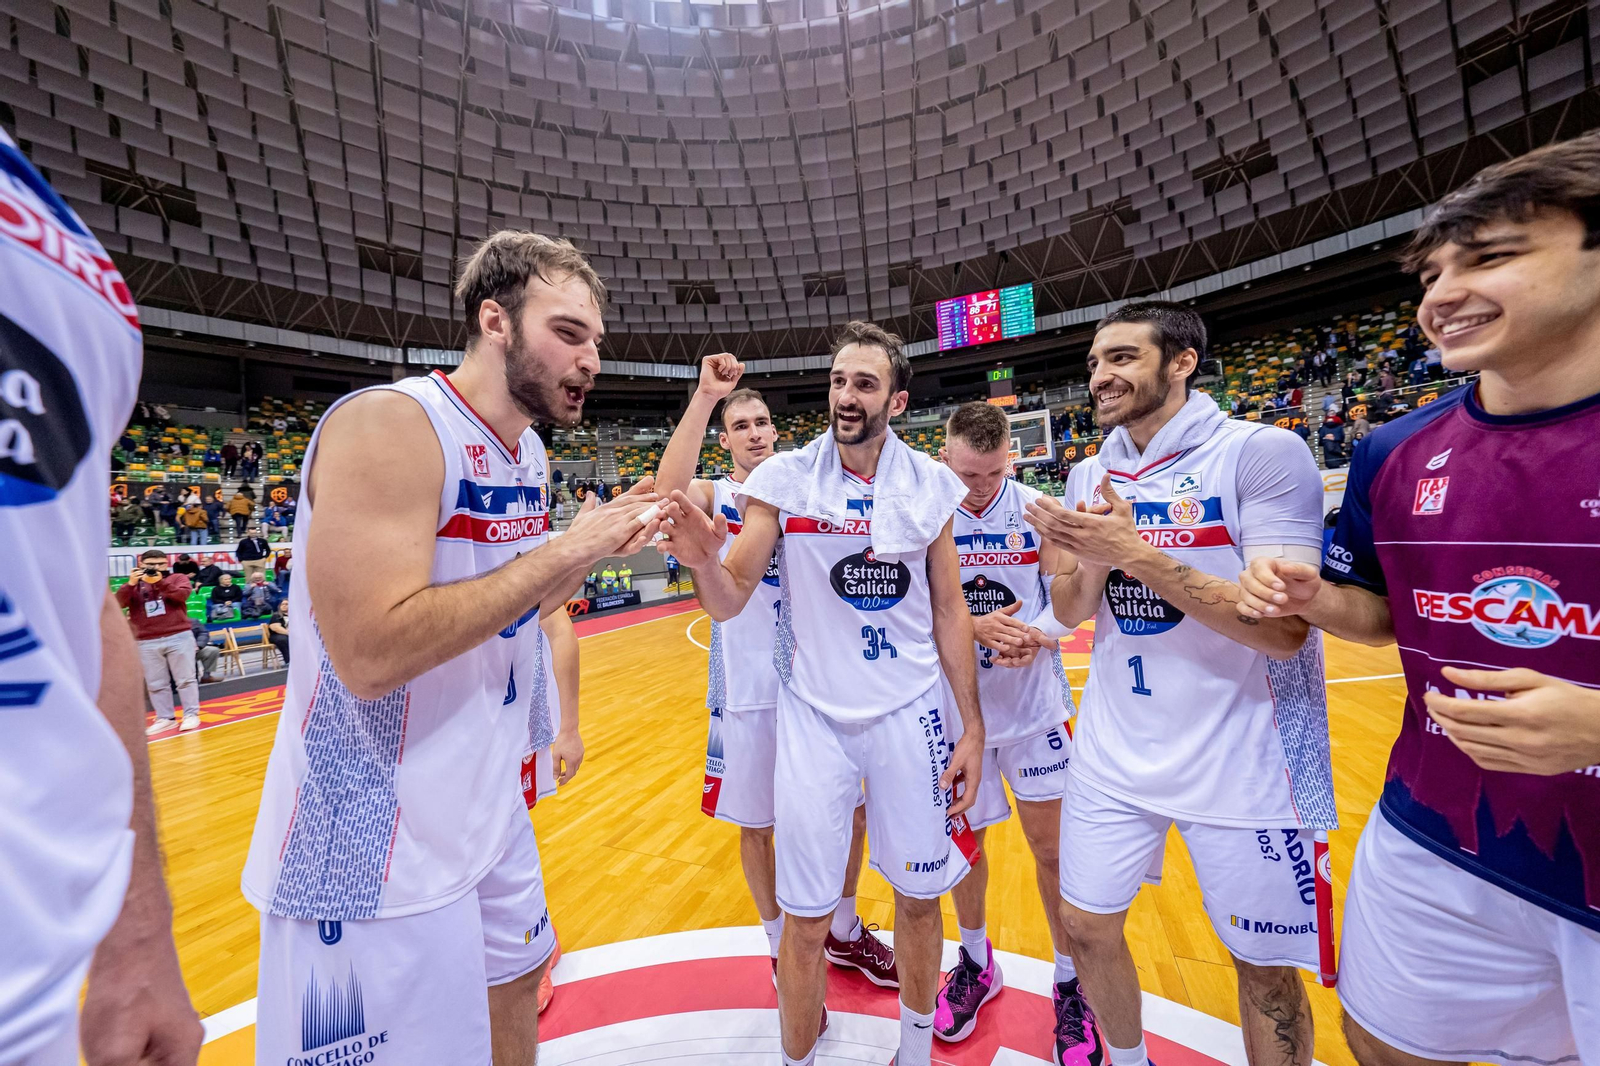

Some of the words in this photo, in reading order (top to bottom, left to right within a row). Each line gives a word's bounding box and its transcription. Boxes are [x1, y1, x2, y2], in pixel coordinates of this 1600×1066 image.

[986, 302, 996, 312] 71
[960, 554, 1022, 566] RADOIRO
[842, 564, 898, 580] Estrella
[844, 580, 896, 595] Galicia
[862, 596, 880, 608] 0,0
[1414, 590, 1600, 639] PESCAM
[1124, 618, 1145, 633] 0,0
[862, 625, 897, 660] 34
[1128, 656, 1151, 696] 1
[1046, 728, 1062, 750] ID
[928, 740, 942, 807] llevamos?
[1256, 829, 1281, 862] os?
[368, 1030, 389, 1048] DE
